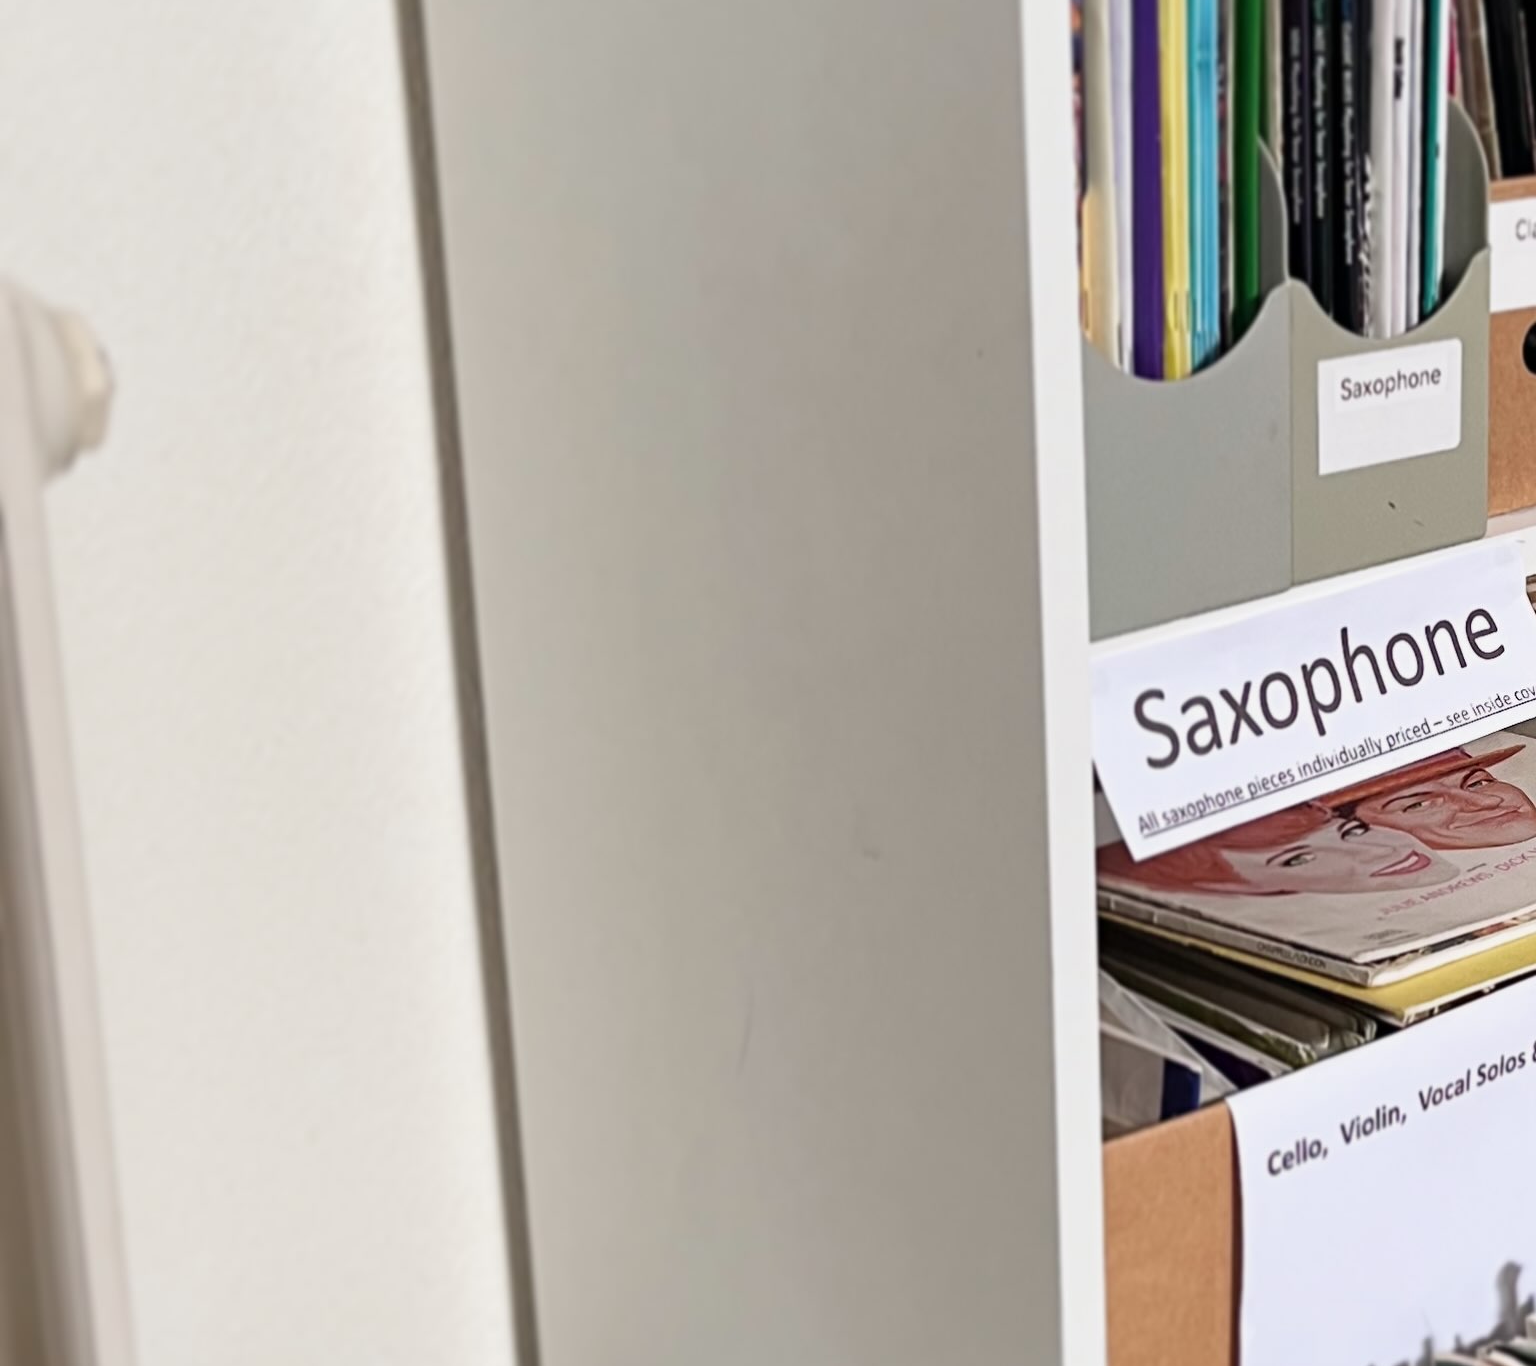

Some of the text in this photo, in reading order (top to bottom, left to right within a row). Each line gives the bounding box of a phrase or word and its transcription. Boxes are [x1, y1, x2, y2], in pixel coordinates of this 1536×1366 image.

[1340, 366, 1442, 402] Saxophone
[1133, 606, 1506, 771] Saxophone
[1138, 812, 1160, 834] All
[1161, 784, 1246, 827] saxophone
[1247, 765, 1296, 802] pieces
[1297, 736, 1384, 779] individually
[1386, 717, 1432, 752] priced
[1446, 707, 1472, 727] see
[1472, 691, 1513, 718] inside
[1494, 853, 1530, 873] DICK
[1266, 1136, 1329, 1177] Cello,
[1339, 1102, 1408, 1146] Violin,
[1417, 1068, 1471, 1112] Vocal
[1475, 1050, 1527, 1088] Solos
